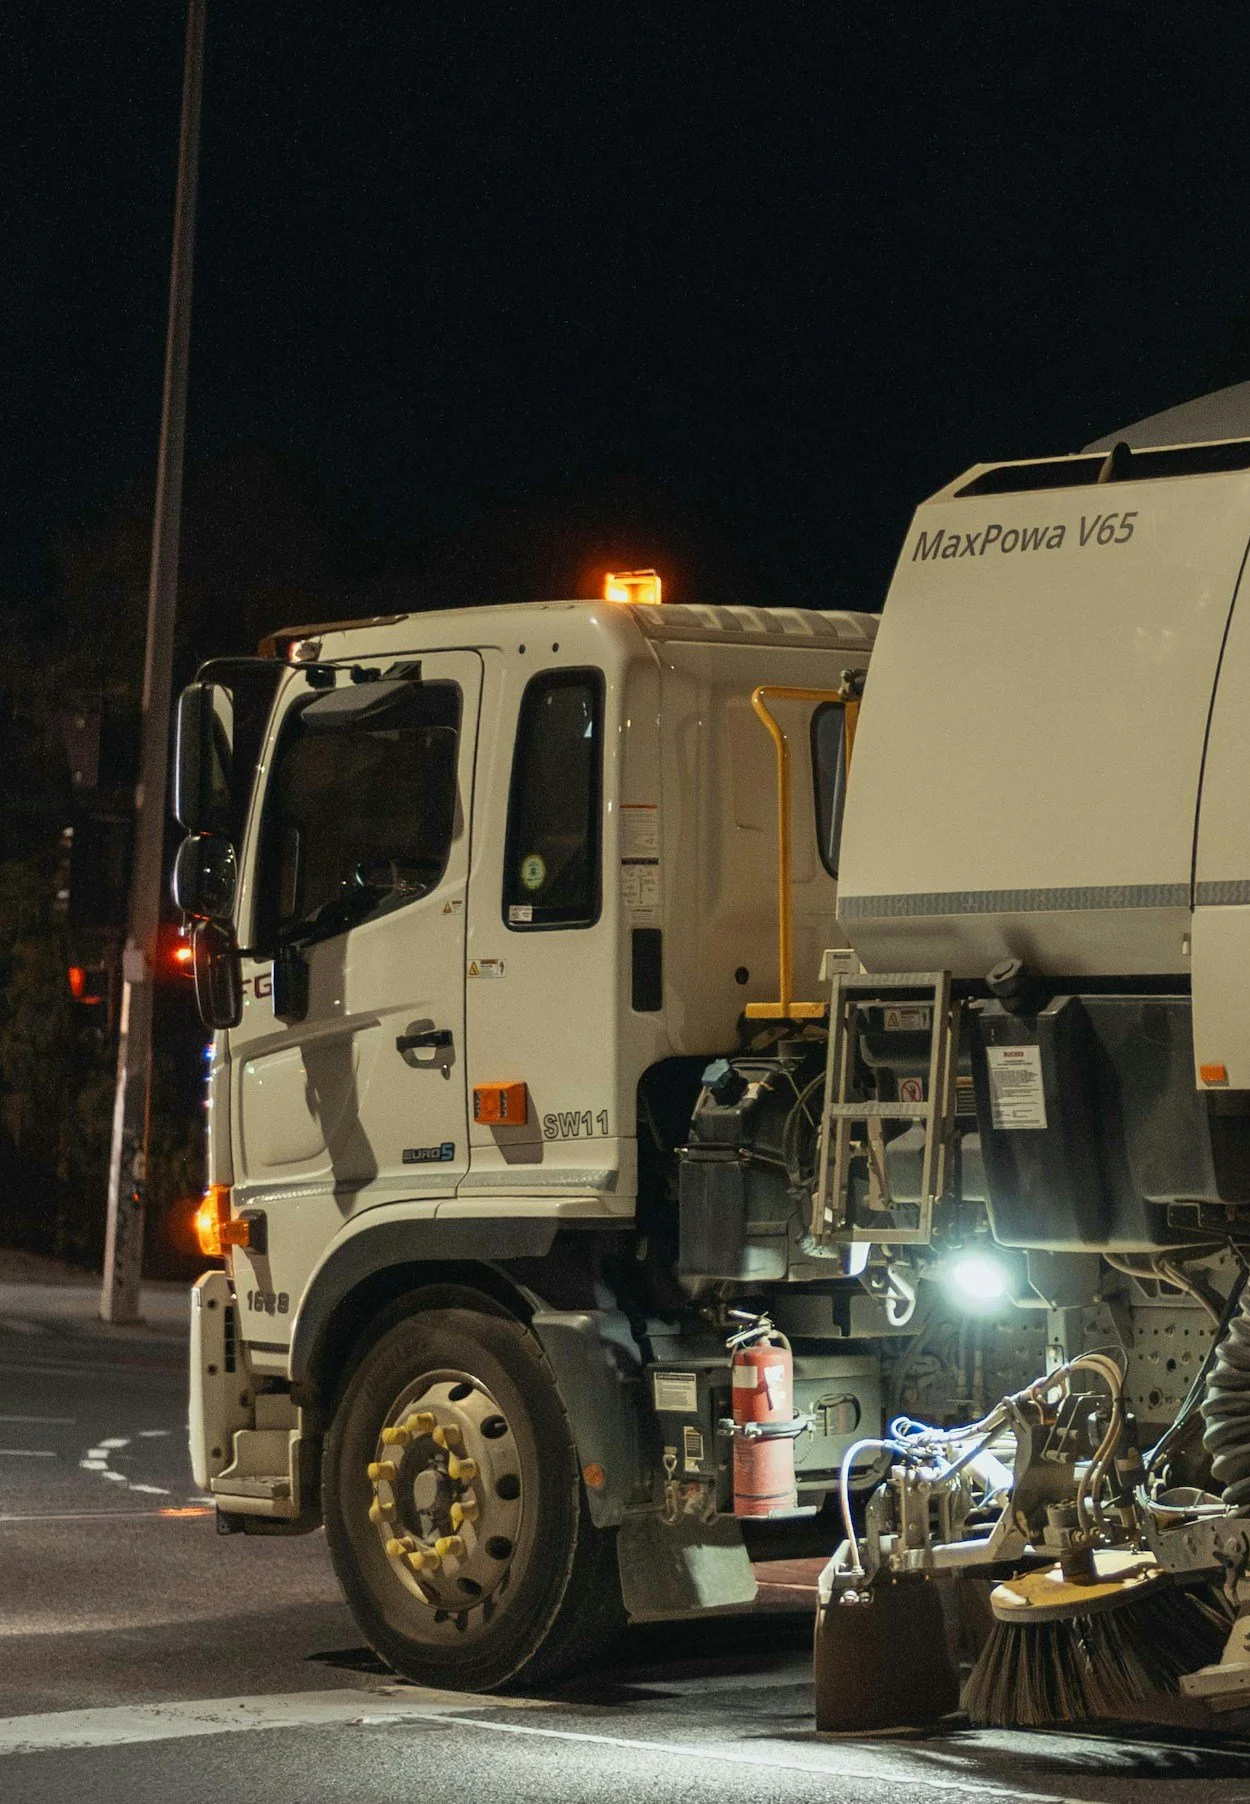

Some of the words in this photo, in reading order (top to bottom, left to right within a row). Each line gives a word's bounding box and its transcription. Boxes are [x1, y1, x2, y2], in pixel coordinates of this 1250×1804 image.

[911, 523, 1066, 562] MaxPowa
[1078, 511, 1139, 547] V65
[543, 1109, 609, 1139] SW11
